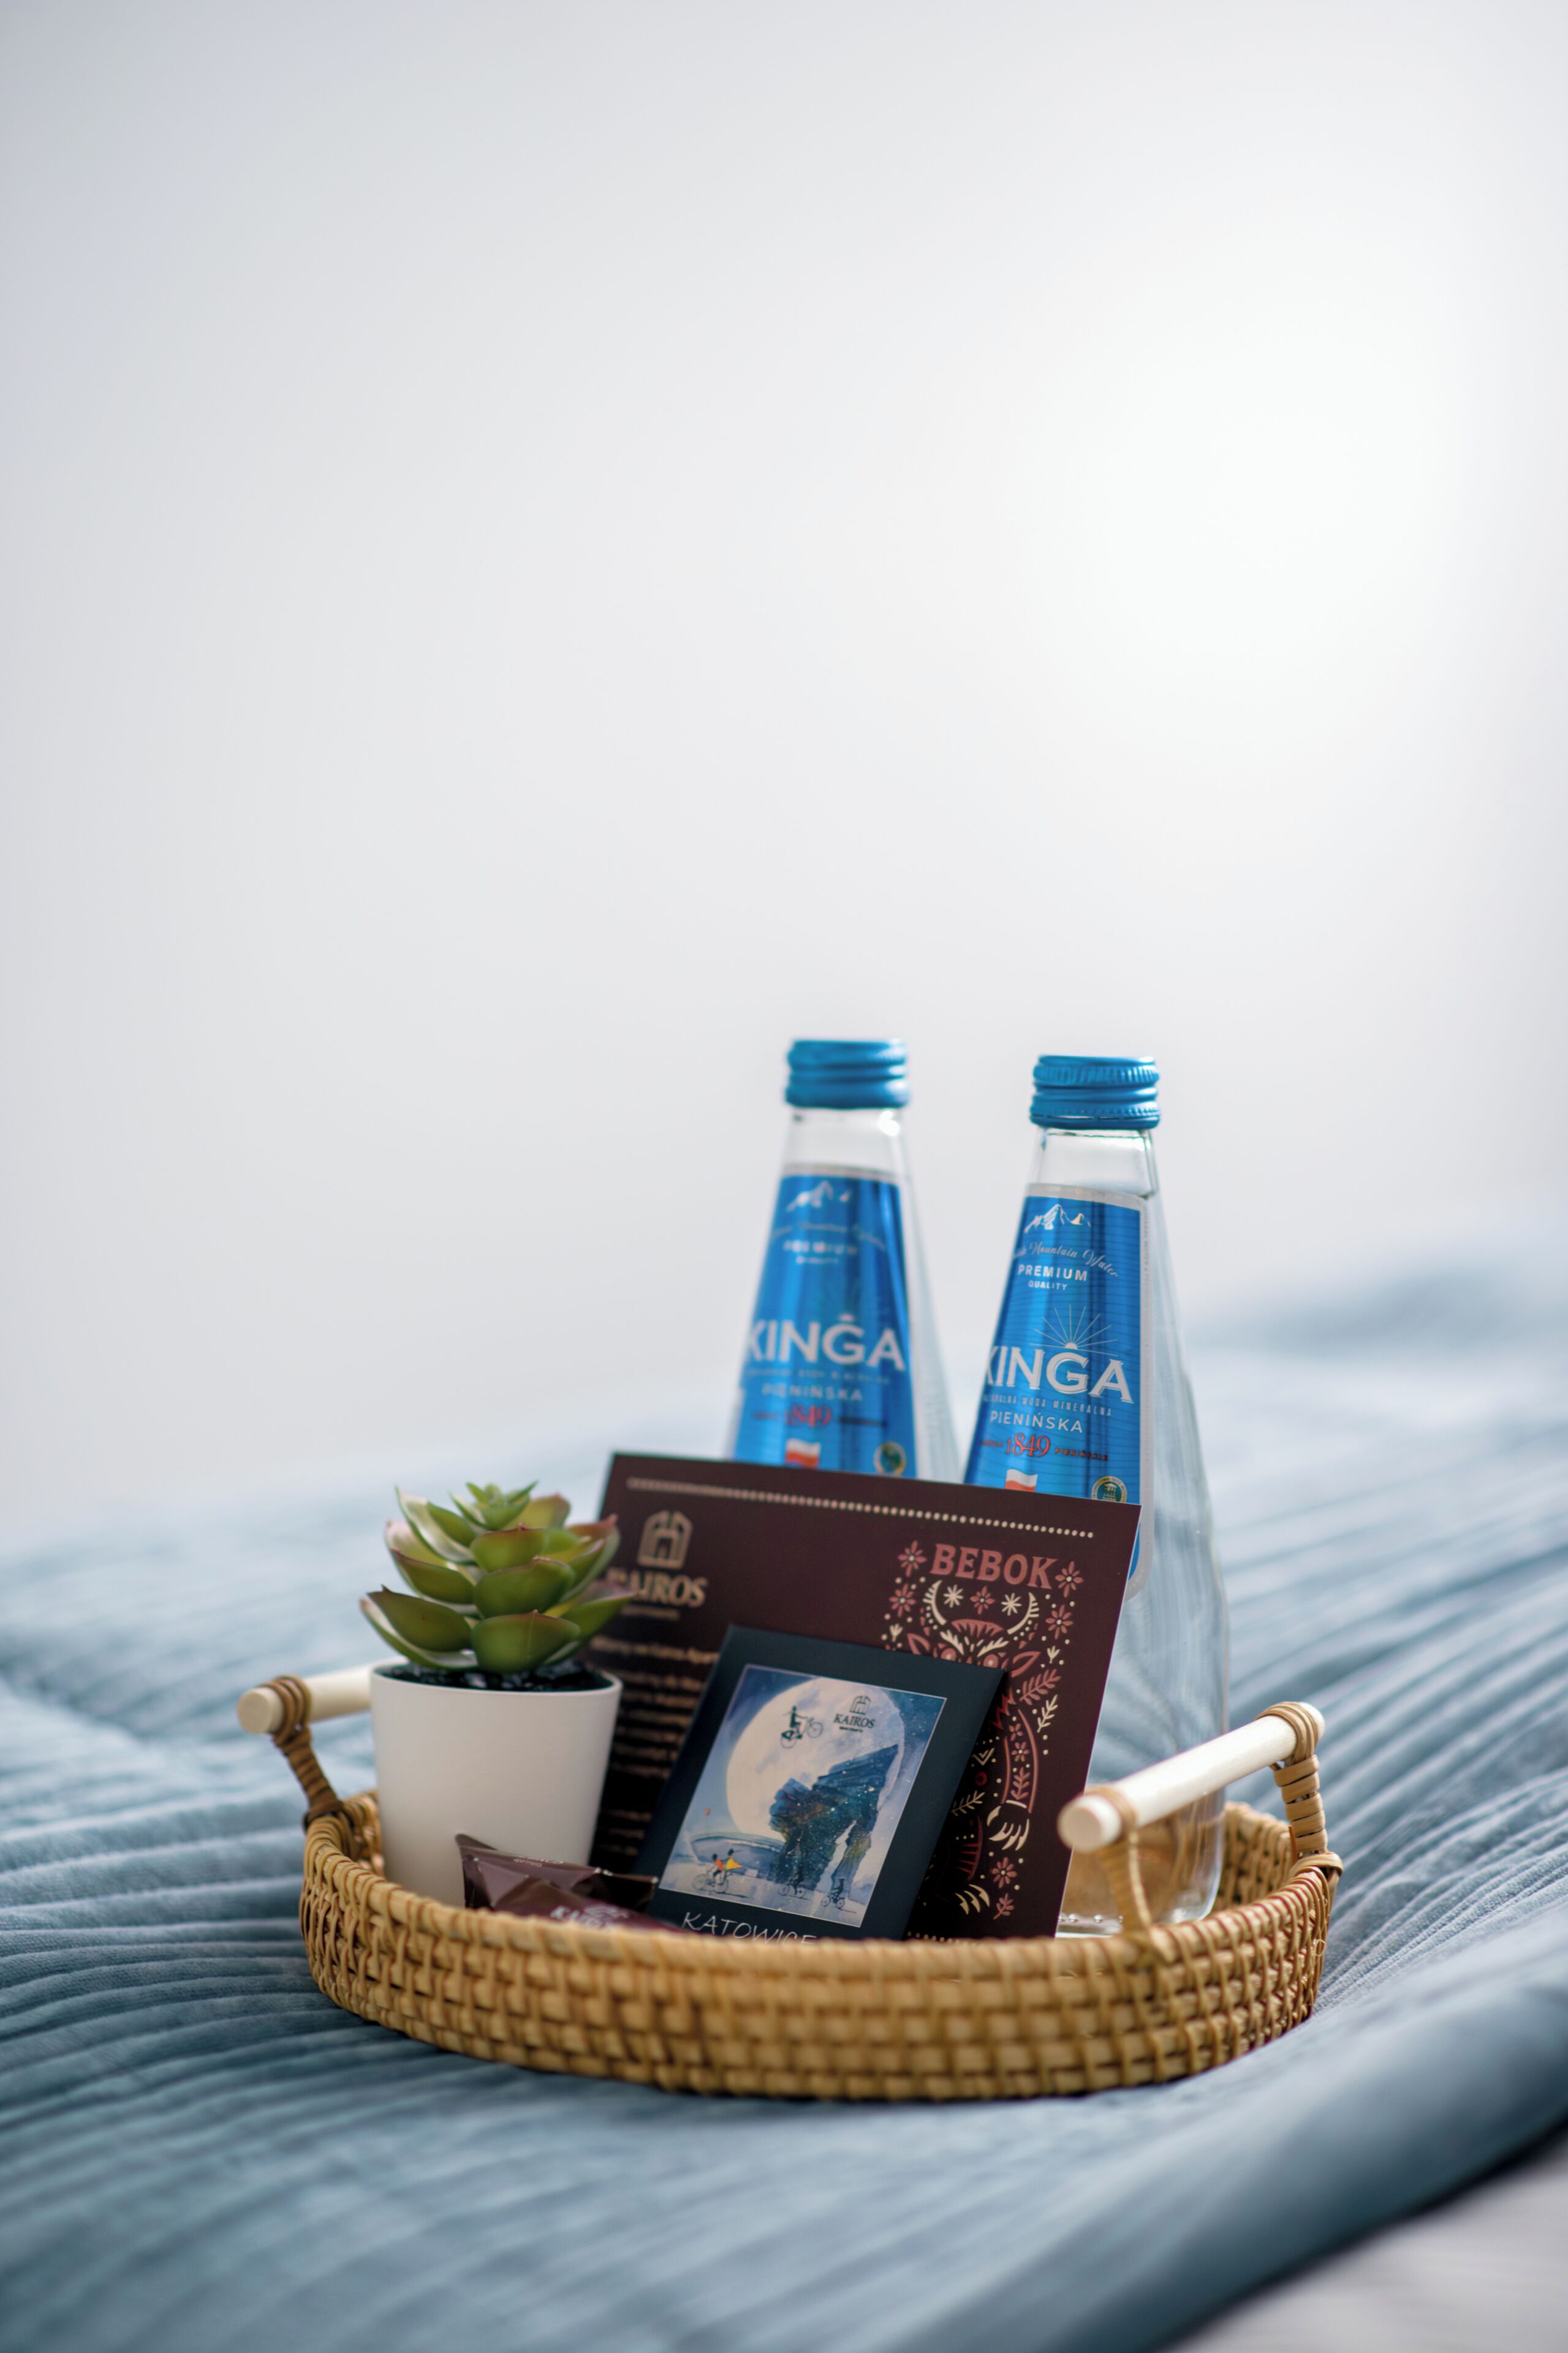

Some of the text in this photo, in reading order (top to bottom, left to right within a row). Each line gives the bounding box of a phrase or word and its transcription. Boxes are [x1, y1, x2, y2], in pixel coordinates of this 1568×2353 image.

[1018, 1264, 1088, 1281] PREMIUM
[1028, 1280, 1067, 1290] QUALITY
[990, 1410, 1083, 1433] PIENIŃSKA
[1006, 1433, 1050, 1458] 1849
[930, 1543, 1058, 1590] BEBOK
[833, 1713, 876, 1729] KAIROS
